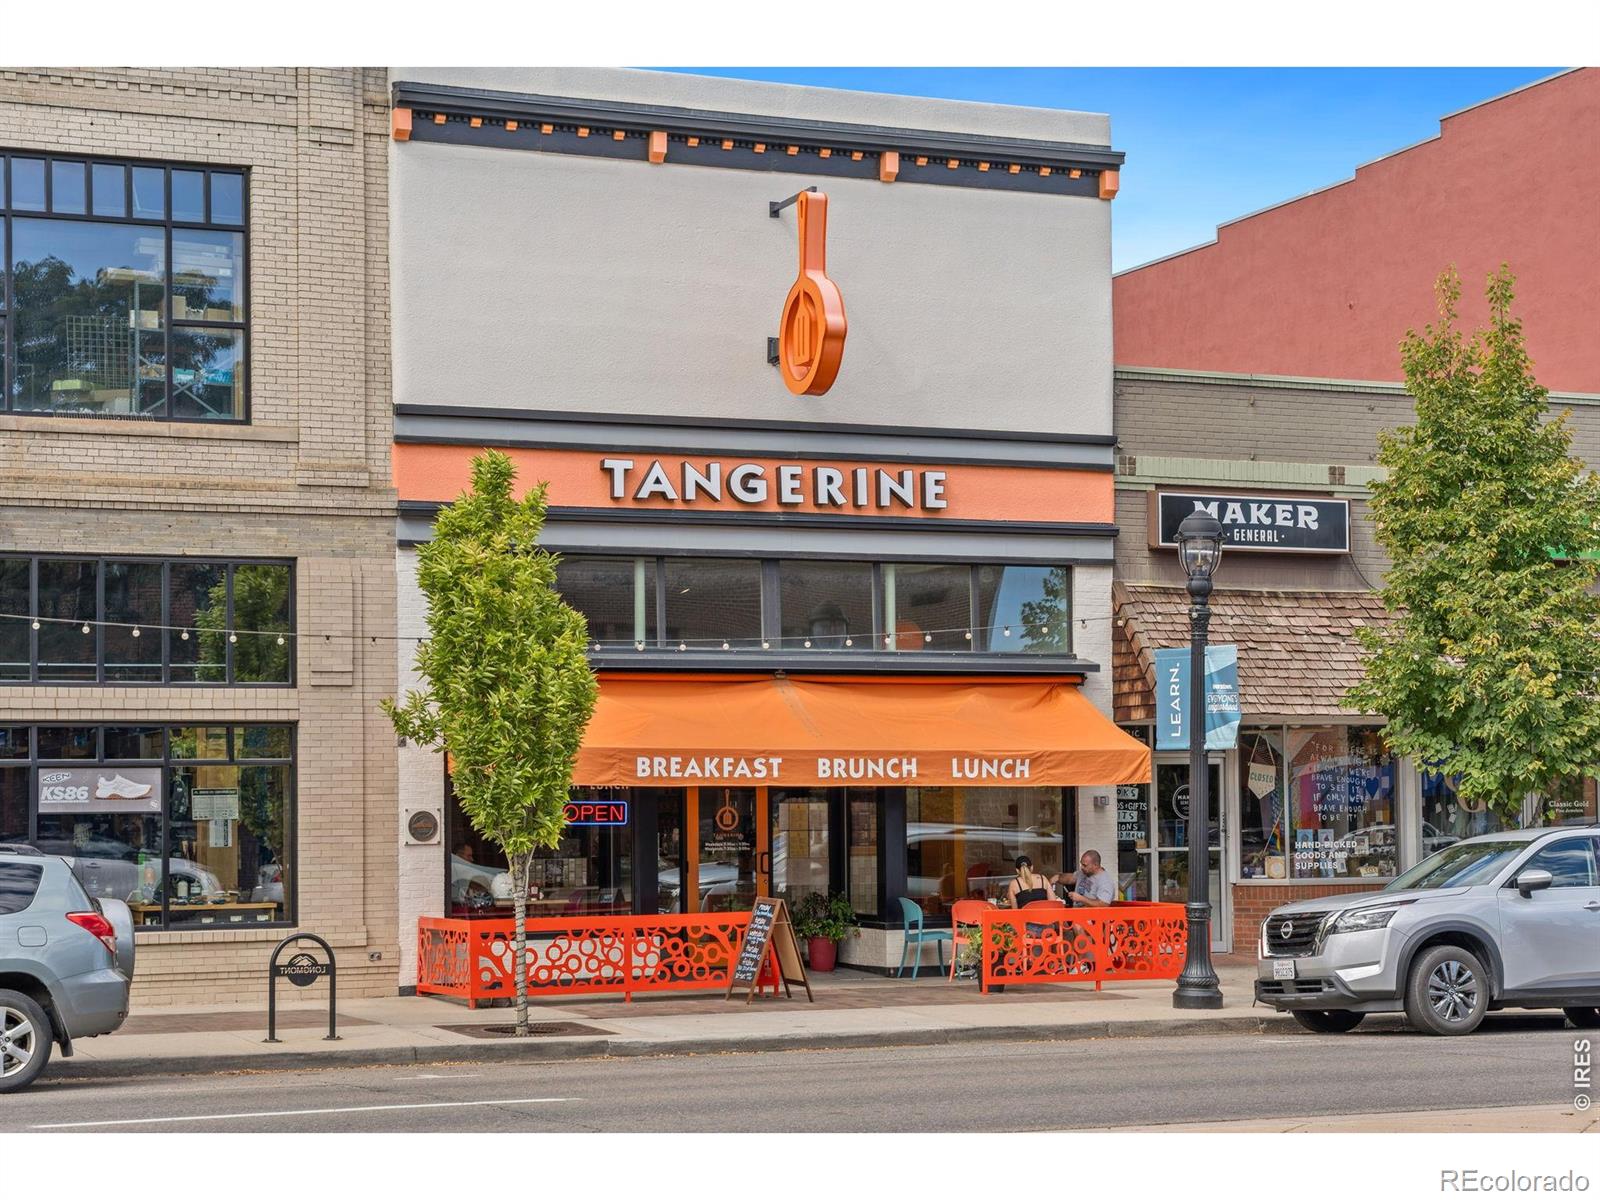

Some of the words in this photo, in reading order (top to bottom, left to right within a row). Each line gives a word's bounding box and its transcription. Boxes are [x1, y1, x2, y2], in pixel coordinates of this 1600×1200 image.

[600, 458, 948, 510] TANGERINE
[1233, 528, 1279, 543] GENERAL
[1169, 662, 1181, 737] LEARN.
[635, 756, 783, 779] BREAKFAST
[816, 757, 918, 779] BRUNCH
[951, 758, 1030, 779] LUNCH
[42, 773, 70, 783] KEEN
[1250, 772, 1274, 783] CLOSED
[1312, 774, 1333, 782] BRAVE
[1316, 783, 1326, 791] TO
[1330, 784, 1345, 792] SEE
[41, 786, 89, 800] KS86
[1326, 794, 1346, 803] ONLY
[563, 804, 624, 821] OPEN
[1313, 804, 1336, 812] BRAVE
[1318, 813, 1328, 822] TO
[1294, 841, 1358, 849] HAND-PICKED
[1294, 851, 1327, 859] GOODS
[1328, 851, 1348, 859] AND
[1295, 861, 1338, 870] SUPPLIES
